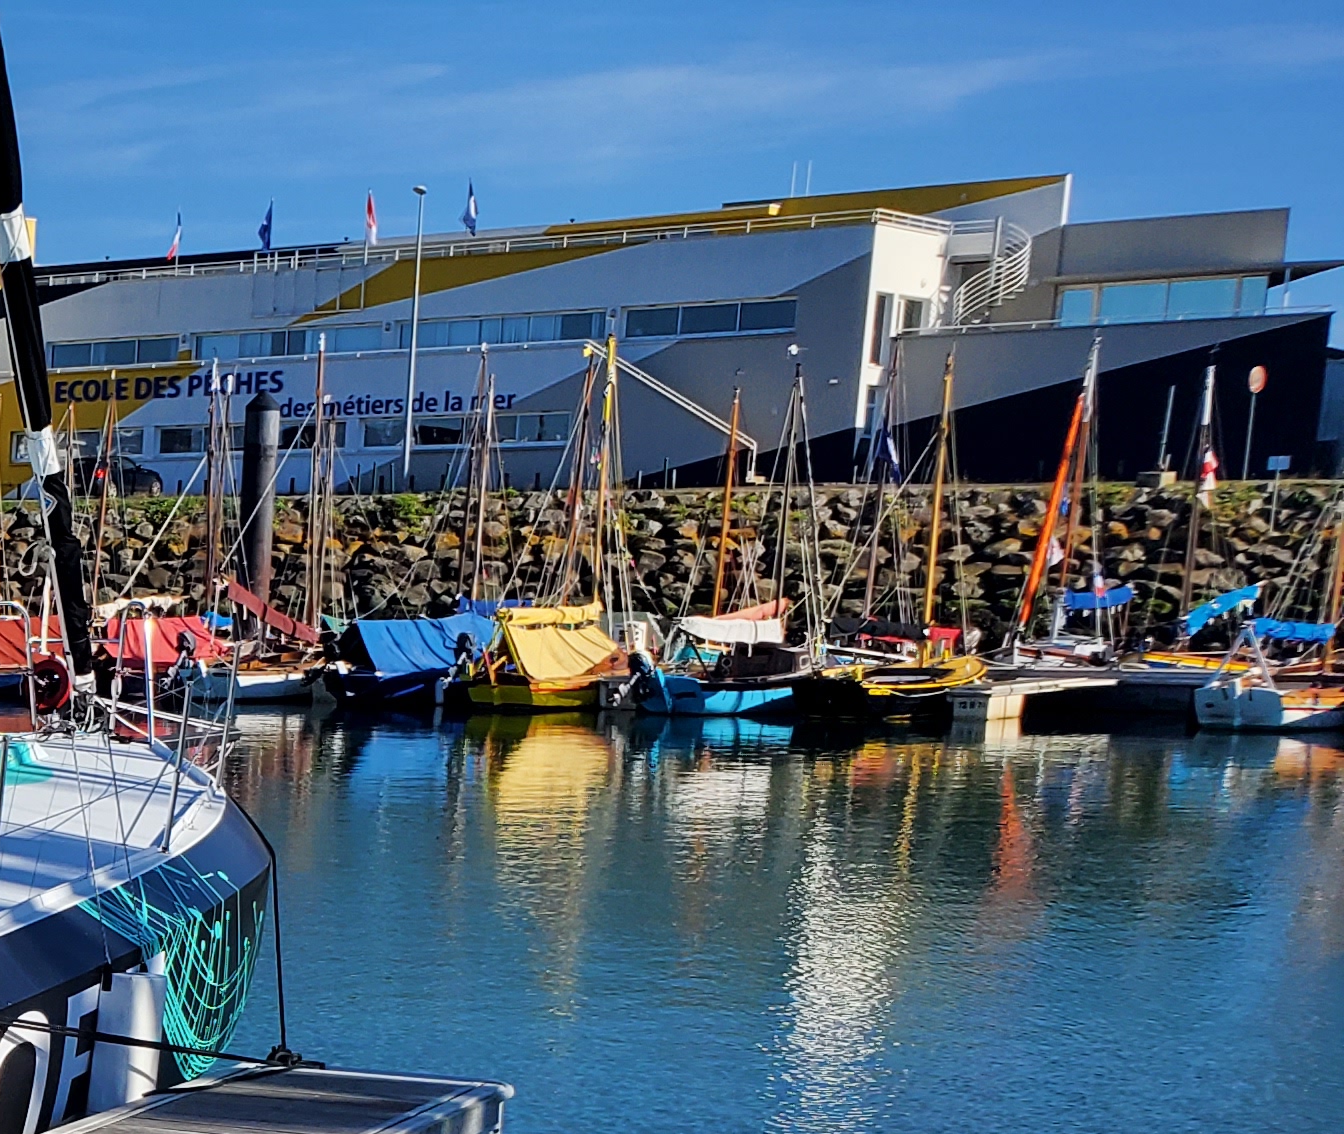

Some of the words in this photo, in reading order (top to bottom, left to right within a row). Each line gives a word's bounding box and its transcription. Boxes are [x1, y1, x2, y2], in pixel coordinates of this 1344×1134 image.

[54, 377, 129, 403] ECOLE
[135, 375, 181, 399] DES
[412, 391, 438, 413] de
[444, 390, 462, 411] la
